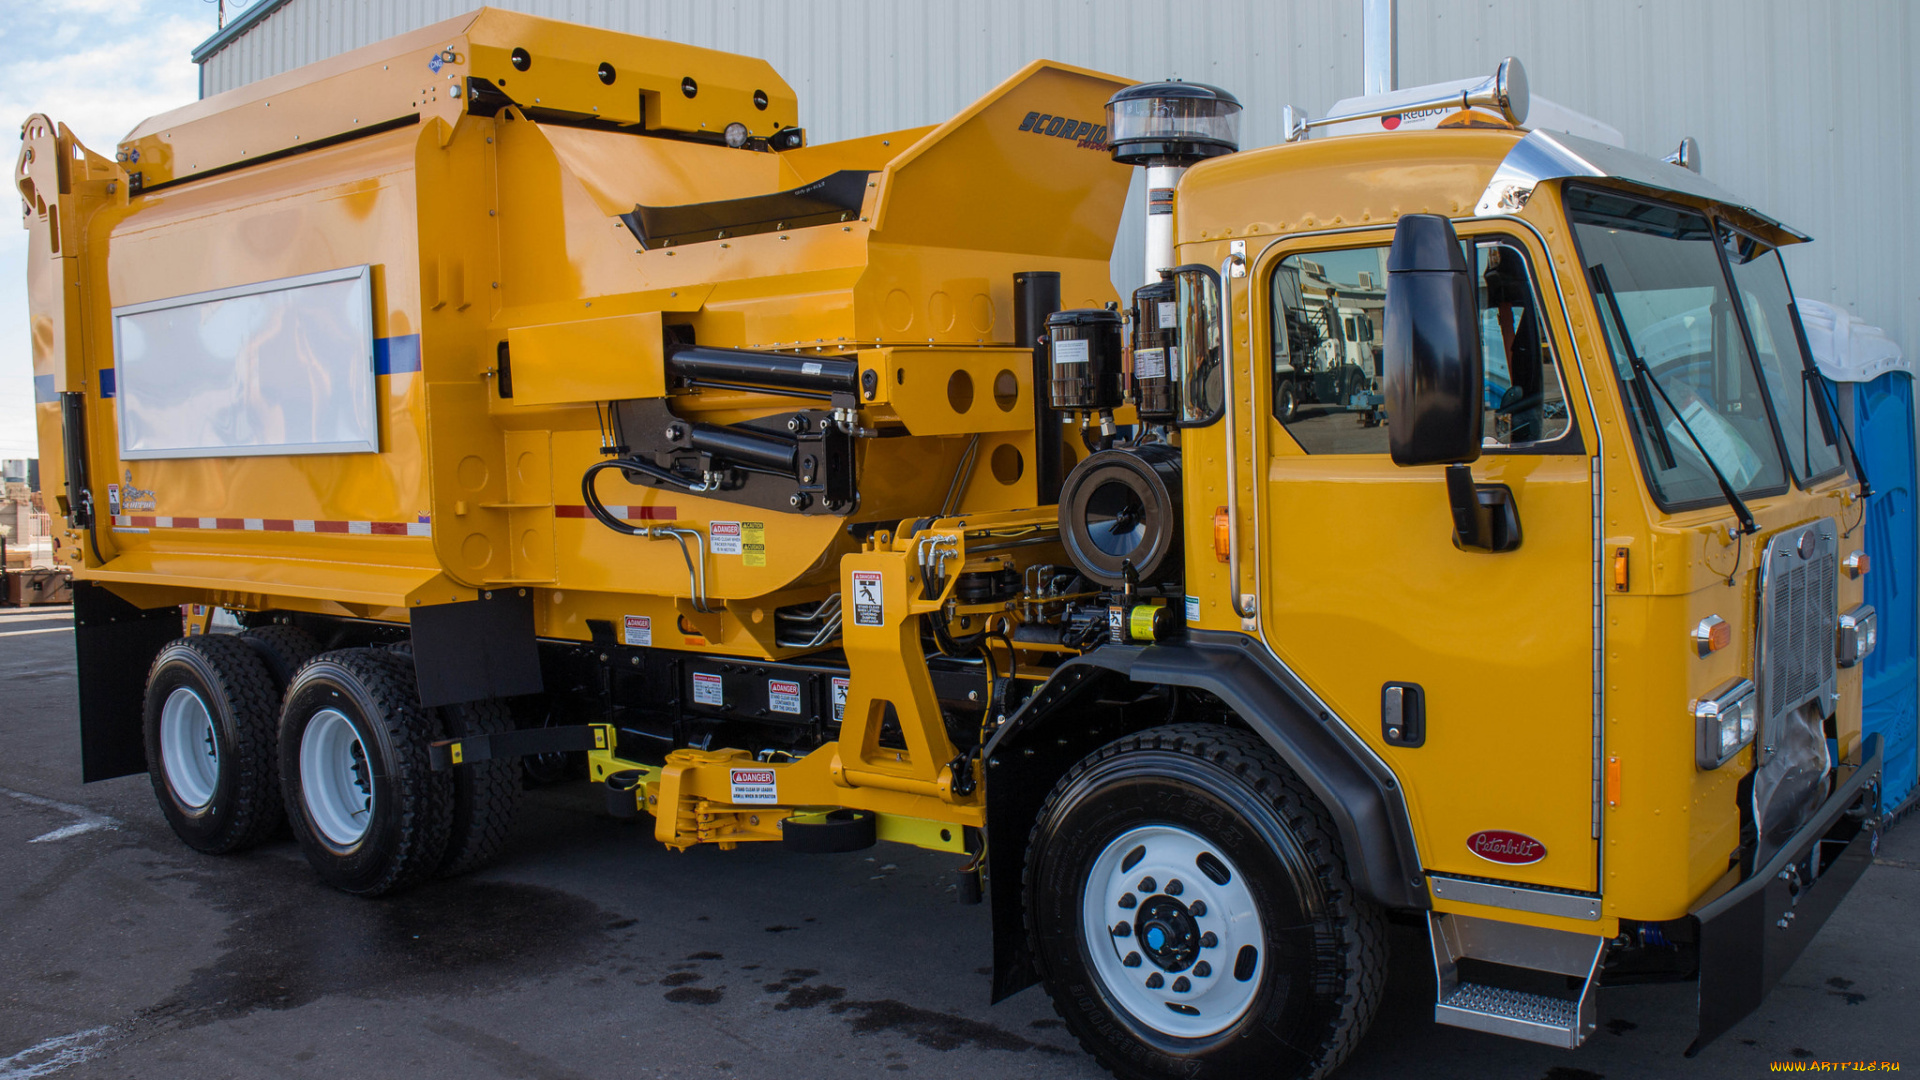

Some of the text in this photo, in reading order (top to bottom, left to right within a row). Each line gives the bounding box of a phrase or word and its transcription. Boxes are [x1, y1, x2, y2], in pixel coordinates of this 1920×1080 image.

[1018, 111, 1107, 145] SCORPIO
[743, 774, 770, 782] DANGER
[1475, 833, 1539, 857] Peterbilt
